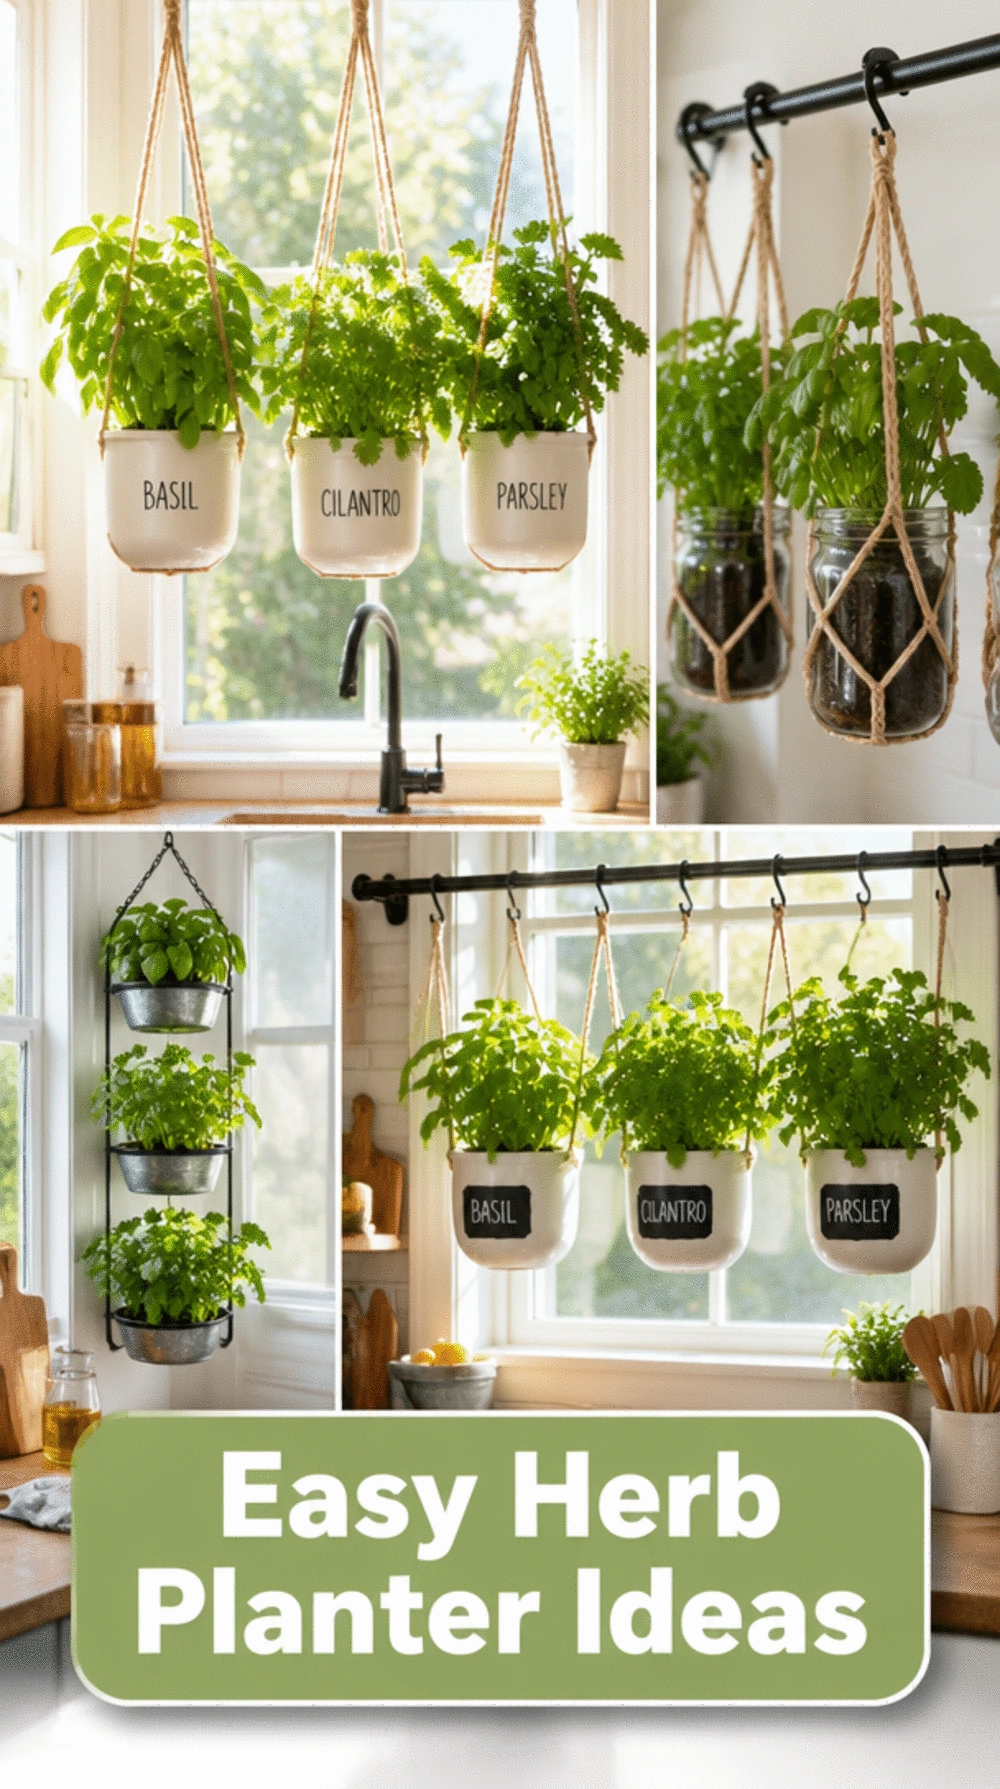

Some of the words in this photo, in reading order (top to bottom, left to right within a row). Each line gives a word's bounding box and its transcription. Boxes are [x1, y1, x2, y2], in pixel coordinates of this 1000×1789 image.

[143, 480, 199, 511] BASIL
[321, 488, 401, 517] CILANTRO
[497, 481, 568, 511] PARSLEY
[471, 1199, 517, 1224] BASIL
[641, 1199, 707, 1223] CILANTRO
[826, 1197, 892, 1223] PARSLEY
